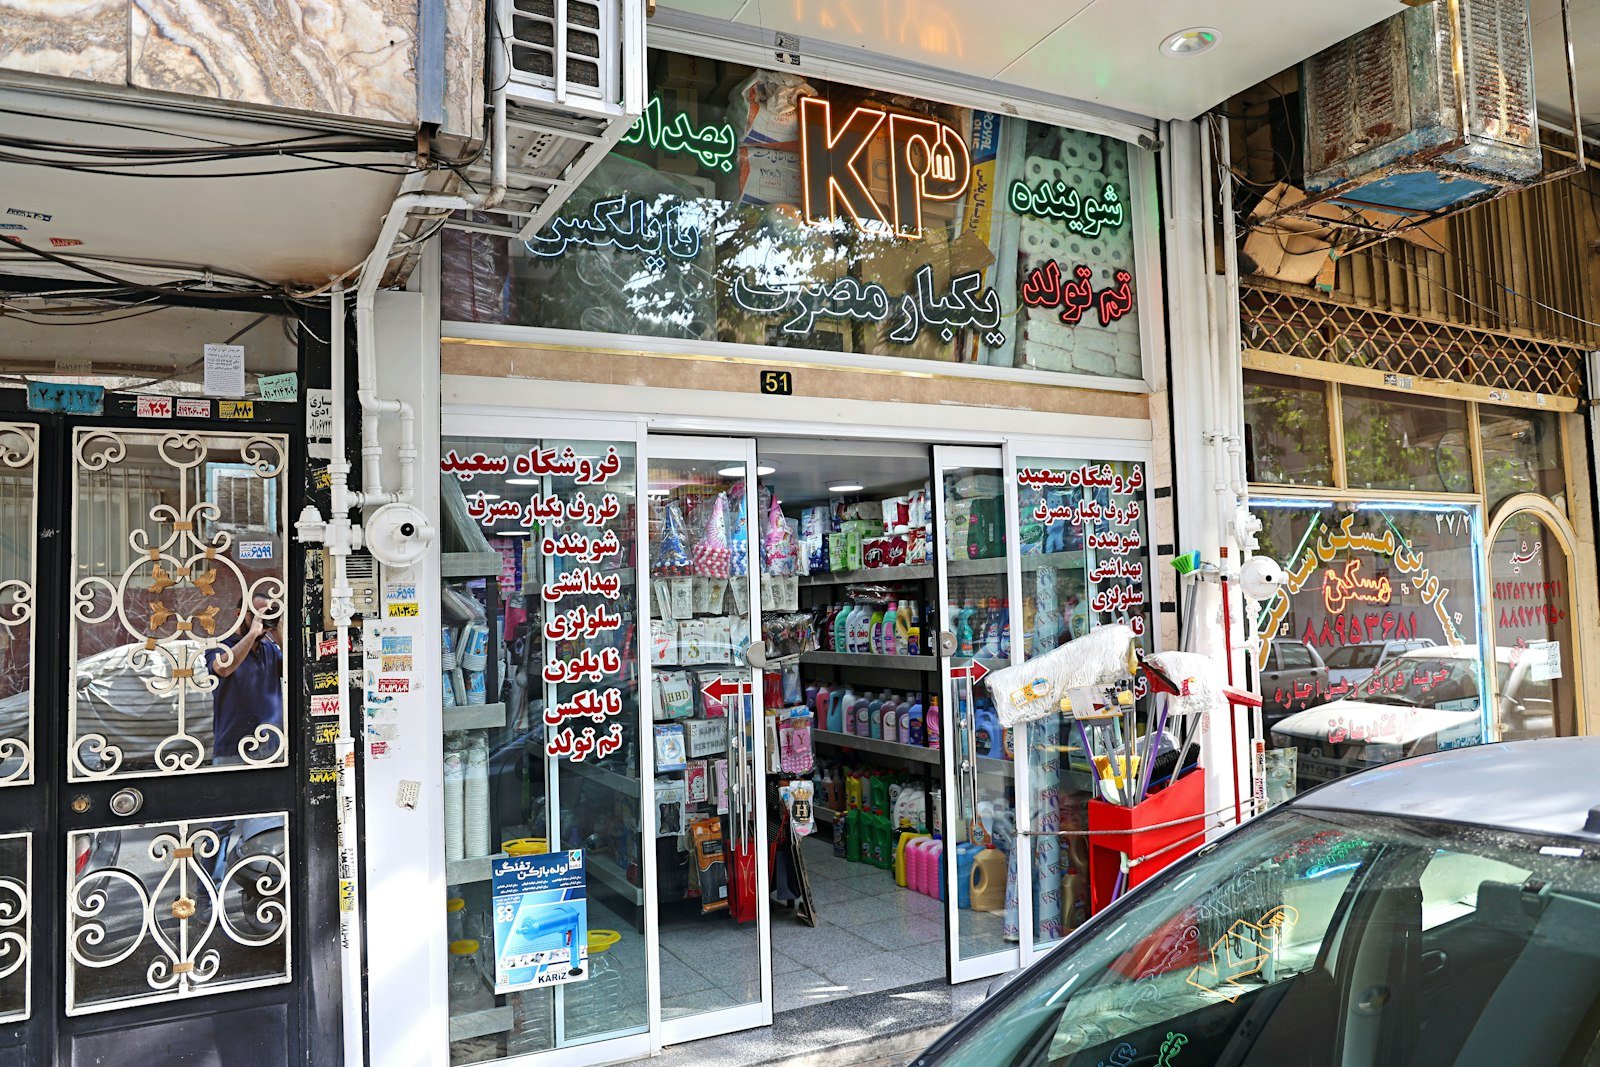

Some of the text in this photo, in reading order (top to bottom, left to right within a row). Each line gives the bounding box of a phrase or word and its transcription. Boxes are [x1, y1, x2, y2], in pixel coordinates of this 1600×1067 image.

[619, 97, 735, 173] بهدا
[1012, 181, 1124, 236] شوینده
[734, 264, 1005, 346] یکبار مصرف
[1023, 261, 1132, 325] تم تولد
[765, 373, 788, 393] 51
[441, 445, 621, 484] فروشگاه سعید
[1017, 463, 1143, 495] فروشگاه سعید
[467, 491, 619, 528] ظروف یکبار مصرف
[1034, 498, 1140, 527] ظروف یکبار مصرف
[541, 530, 619, 564] شوینده
[1088, 528, 1141, 555] شوینده
[1317, 513, 1395, 561] مسکن
[543, 569, 620, 601] بهداشتی
[1088, 557, 1142, 584] بهداشتی
[1322, 559, 1393, 615] مسکن
[1091, 584, 1143, 612] سلولزی
[545, 604, 621, 641] سلولزی
[1302, 610, 1418, 647] ۸۸۹۵۳۶۸۱
[543, 647, 620, 684] نایلون
[1367, 660, 1404, 695] فروش
[1412, 659, 1449, 692] خرید
[543, 688, 622, 727] نایلکس
[667, 688, 689, 704] HBD
[1275, 676, 1320, 709] اجاره
[546, 725, 622, 763] تم تولد
[795, 803, 808, 817] H
[495, 861, 568, 880] لوله بازکن تفنگی
[538, 972, 567, 984] KARiZ
